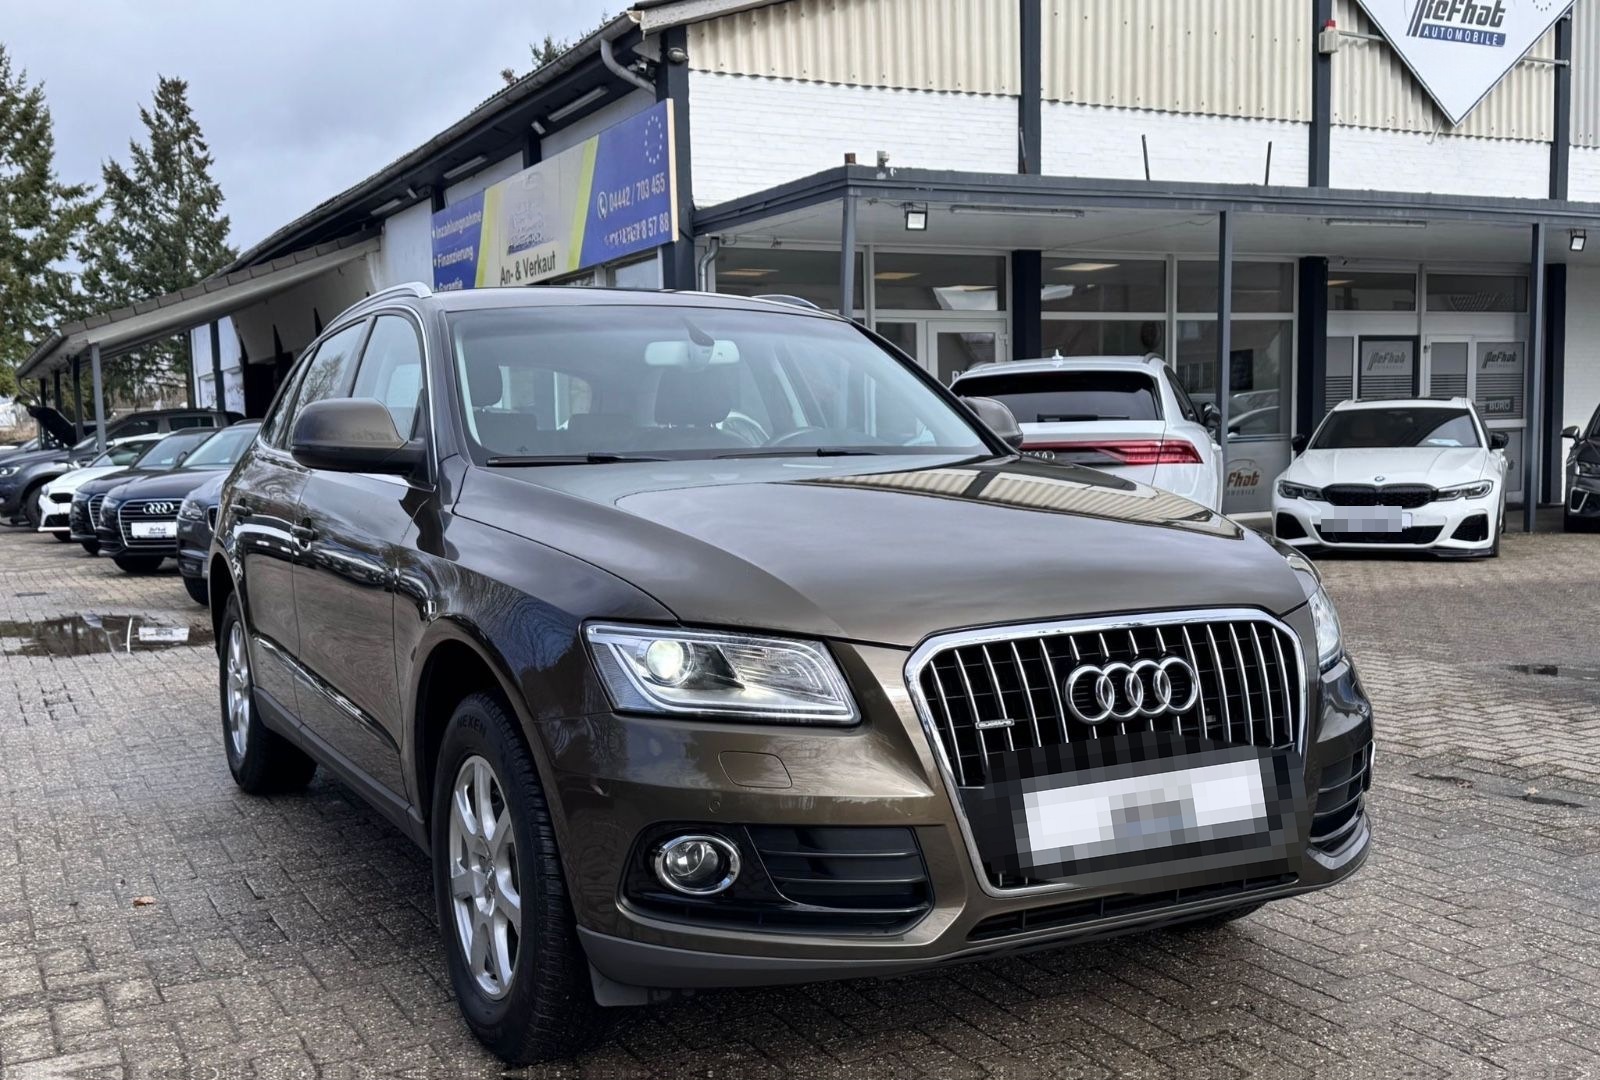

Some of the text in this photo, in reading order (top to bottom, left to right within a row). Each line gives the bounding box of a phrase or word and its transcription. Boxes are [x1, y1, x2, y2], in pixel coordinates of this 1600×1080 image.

[1422, 25, 1499, 46] AUTOMOBILE
[609, 186, 631, 212] 04442
[636, 178, 650, 202] 703
[651, 171, 666, 195] 455
[659, 211, 670, 233] 88
[515, 260, 522, 281] &
[522, 250, 557, 278] Verkauf
